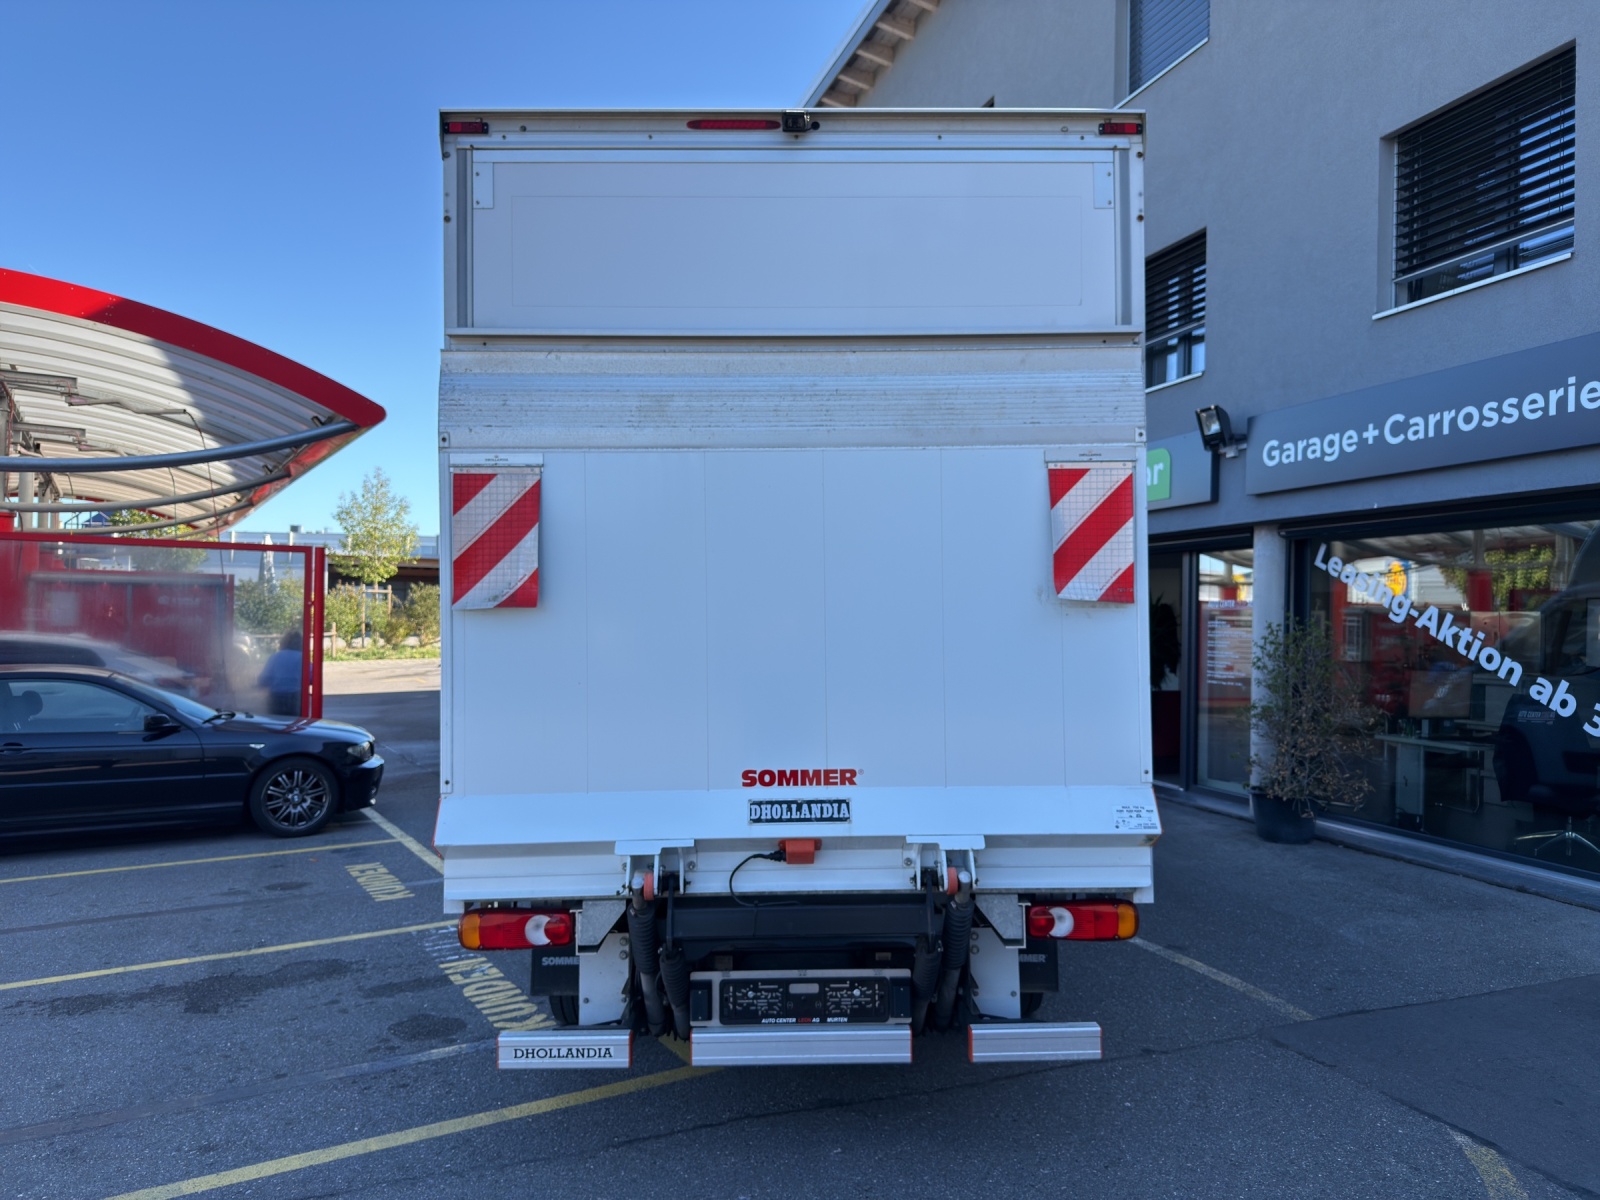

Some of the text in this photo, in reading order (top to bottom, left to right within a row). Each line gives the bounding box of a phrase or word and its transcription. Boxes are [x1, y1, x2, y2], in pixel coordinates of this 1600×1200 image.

[1314, 543, 1523, 687] Leasing-Aktion
[1529, 677, 1577, 718] ab
[750, 802, 850, 820] DHOLLANDIA
[438, 956, 557, 1031] KUNDEN
[513, 1047, 613, 1059] DHOLLANDIA
